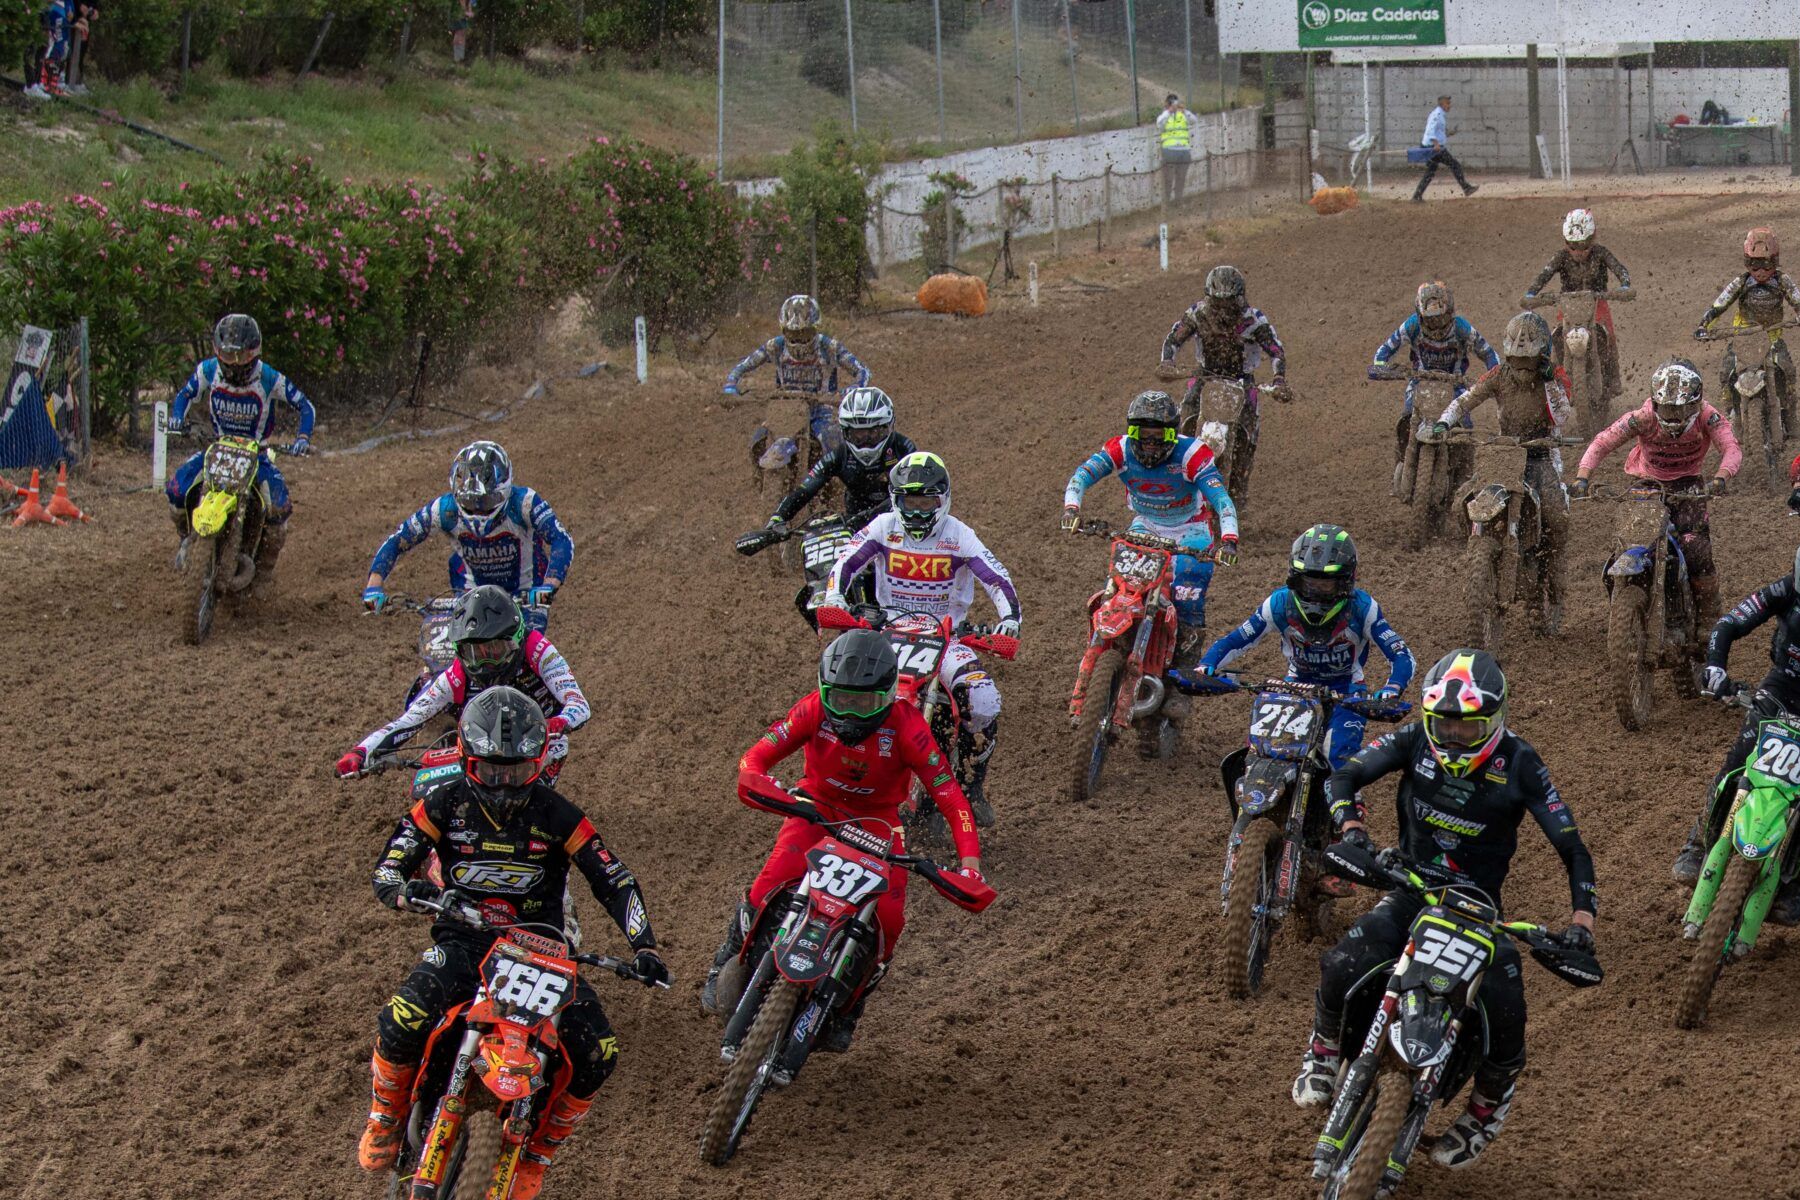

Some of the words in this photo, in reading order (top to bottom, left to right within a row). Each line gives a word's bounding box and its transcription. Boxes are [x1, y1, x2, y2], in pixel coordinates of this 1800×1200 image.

[1334, 8, 1368, 23] Díaz
[1372, 7, 1440, 23] Cadenas
[213, 397, 259, 415] YAMAHA
[889, 552, 952, 578] FXR
[1250, 703, 1313, 740] 214
[1425, 816, 1481, 836] RACING
[1430, 809, 1486, 831] TRIUMPH
[841, 830, 886, 855] RENTHAL
[843, 823, 889, 848] RENTHAL
[810, 854, 883, 904] 337
[512, 931, 565, 952] RENTHAL
[488, 957, 568, 1016] 166
[1325, 1068, 1356, 1133] DUNLOP
